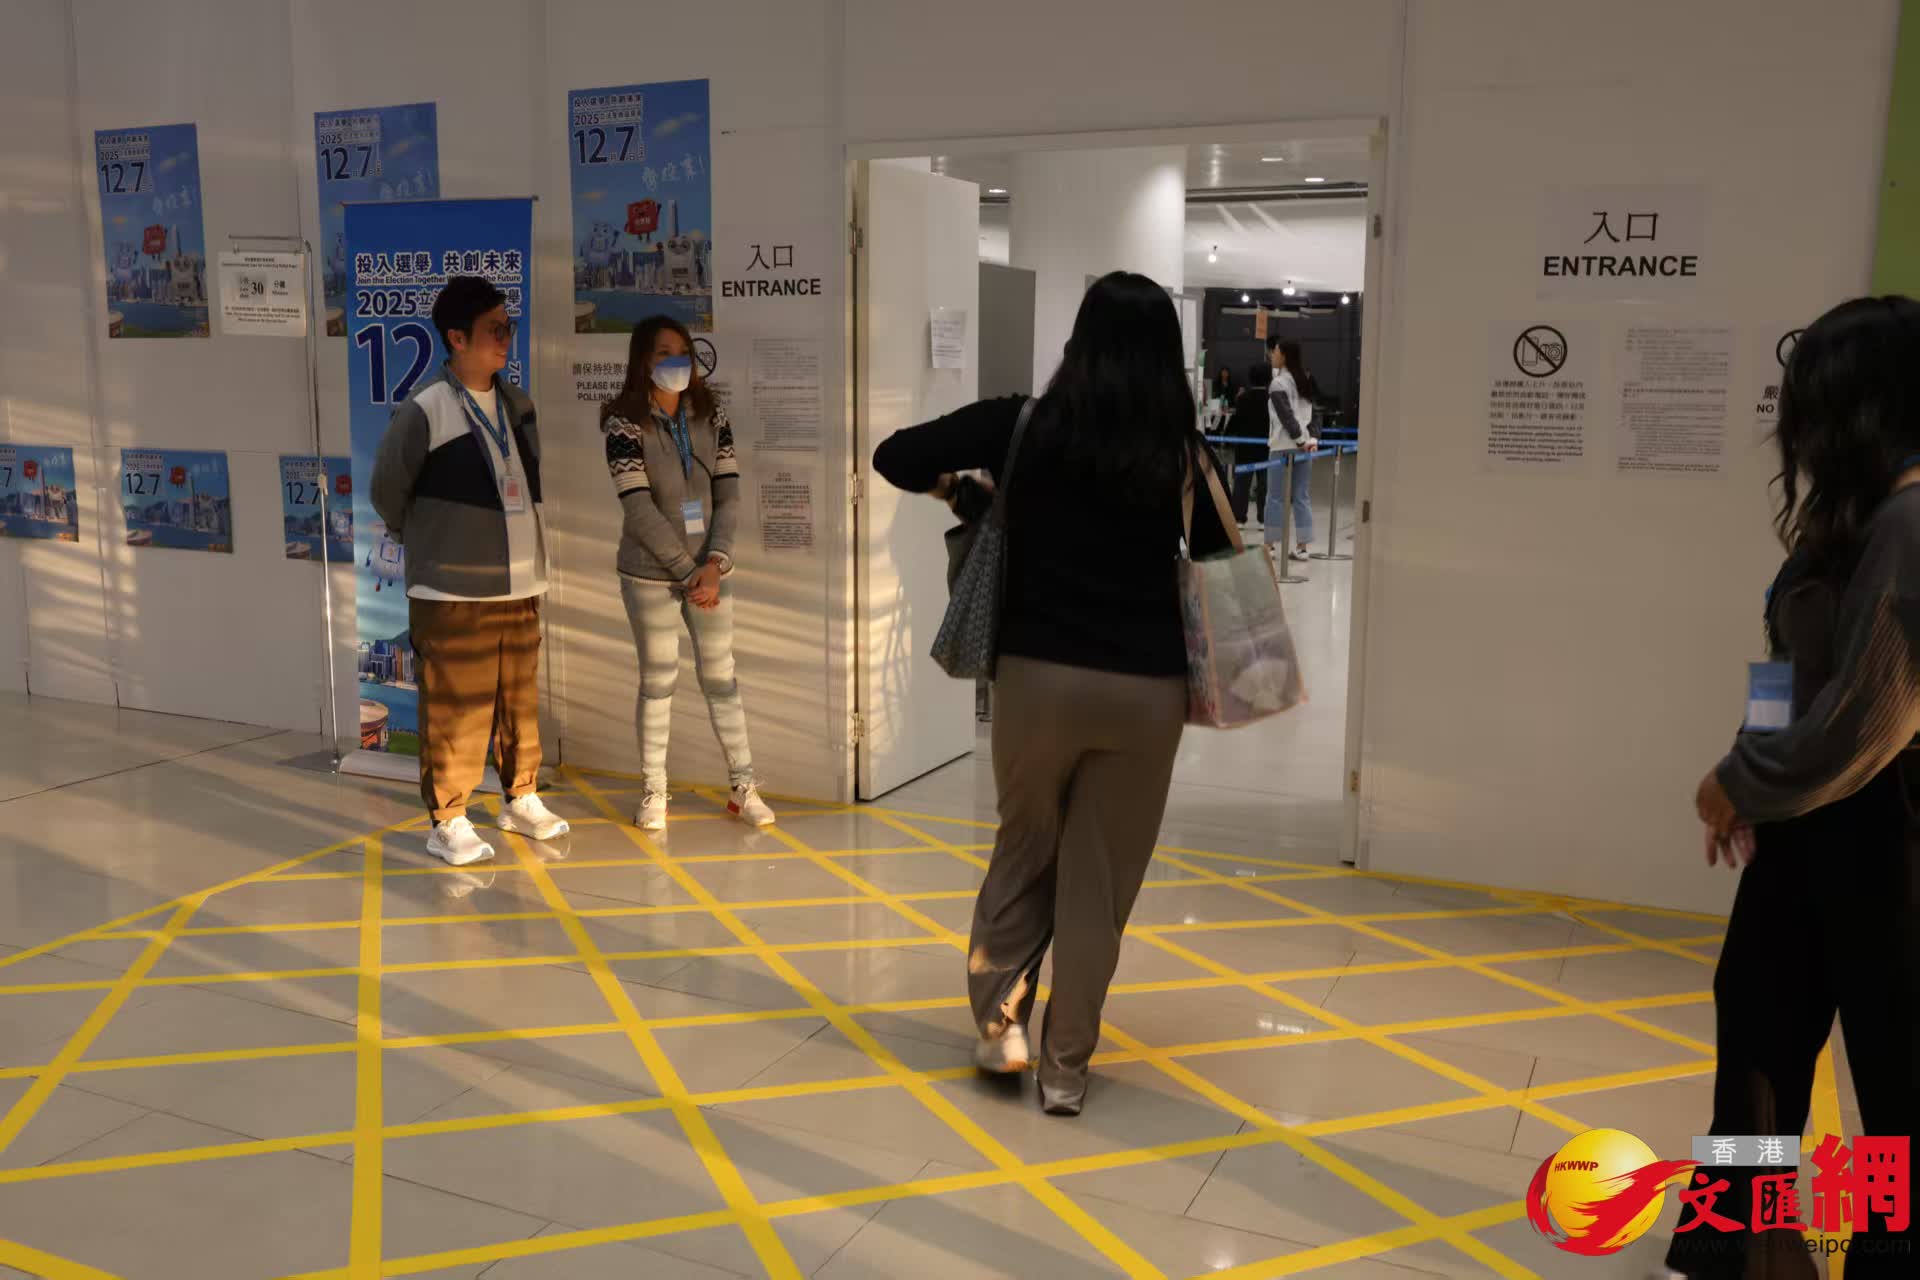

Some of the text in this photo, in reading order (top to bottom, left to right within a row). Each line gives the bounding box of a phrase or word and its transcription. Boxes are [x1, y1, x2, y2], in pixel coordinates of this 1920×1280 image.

[1583, 210, 1659, 245] 入口
[356, 252, 522, 274] 投入選舉 共創未來
[746, 243, 794, 272] 入口
[1543, 255, 1698, 277] ENTRANCE
[251, 281, 264, 295] 30
[357, 277, 372, 285] Join
[373, 277, 385, 285] the
[386, 276, 414, 284] Election
[415, 275, 446, 286] Together
[497, 274, 522, 283] Future
[722, 278, 822, 298] ENTRANCE
[576, 381, 608, 390] PLEASE
[1756, 403, 1775, 414] NO
